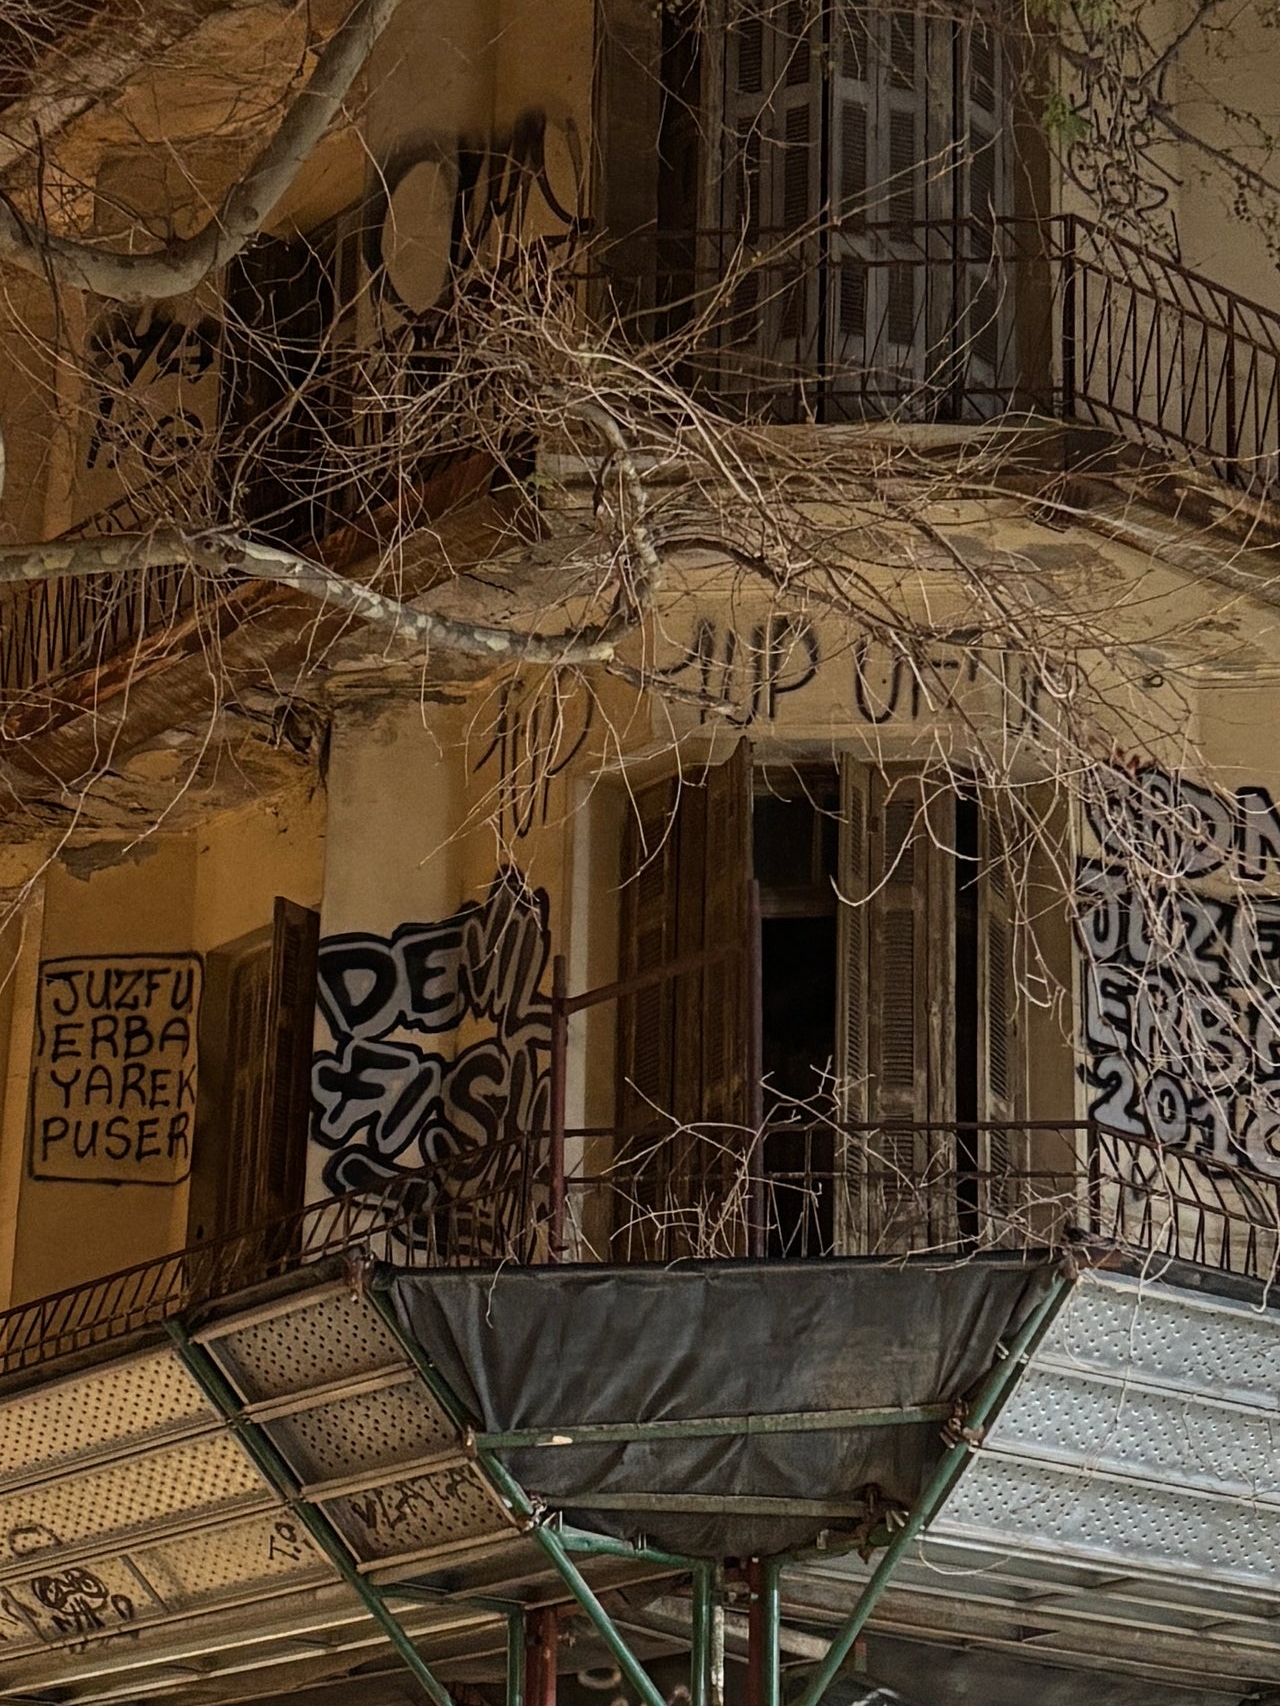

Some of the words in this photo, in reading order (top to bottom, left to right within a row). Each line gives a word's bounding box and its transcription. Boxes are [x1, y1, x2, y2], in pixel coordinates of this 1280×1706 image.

[45, 968, 194, 1015] JUZFU
[51, 1014, 190, 1062] ERBA
[50, 1062, 196, 1110] YAREK
[42, 1111, 189, 1162] PUSER
